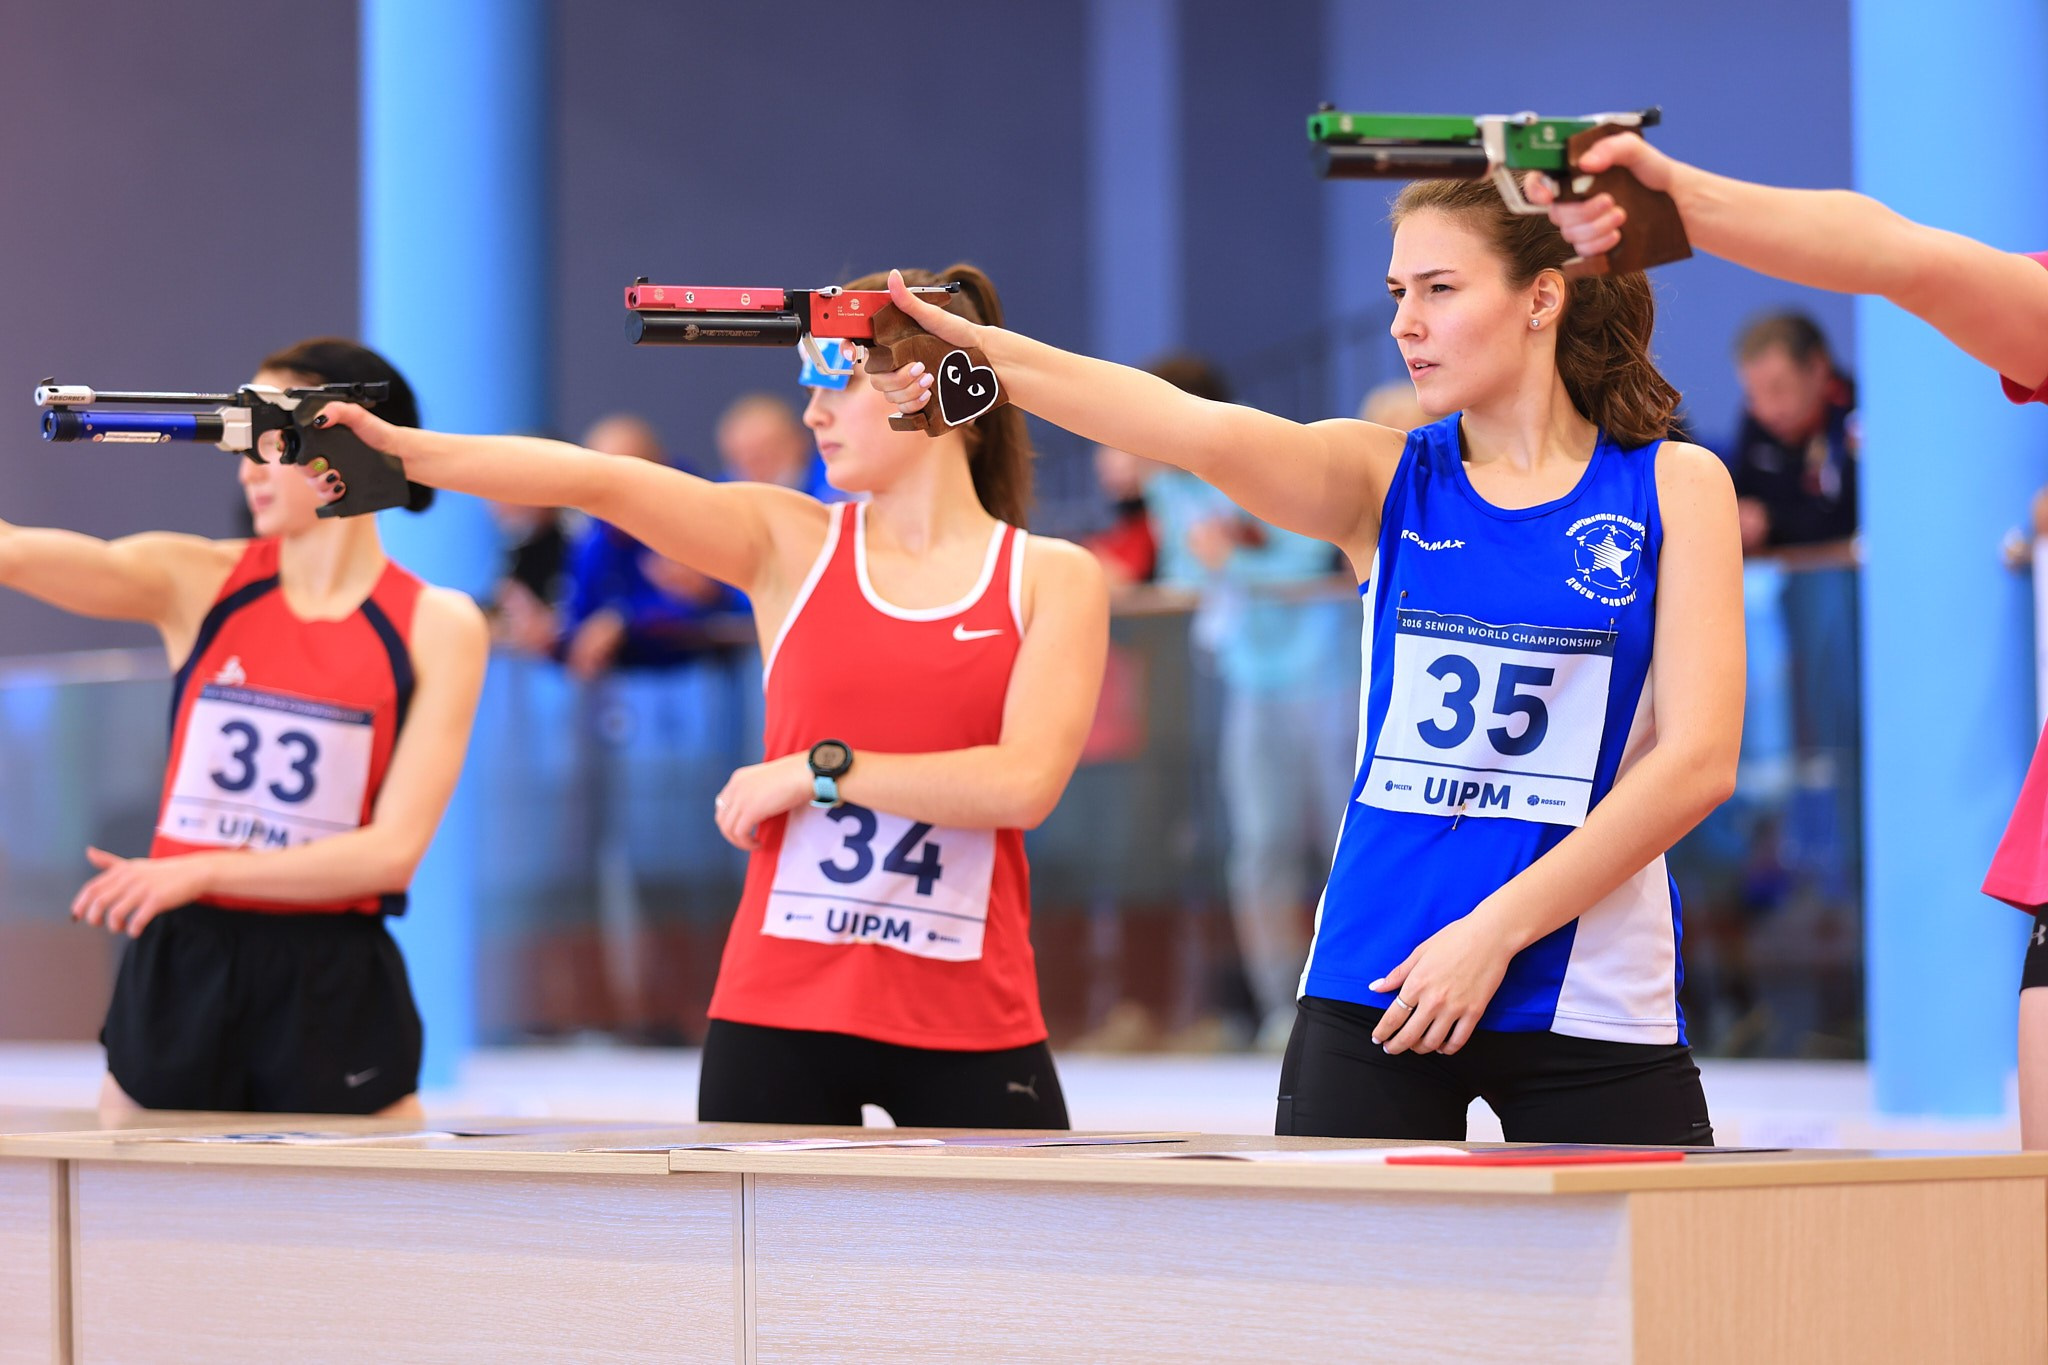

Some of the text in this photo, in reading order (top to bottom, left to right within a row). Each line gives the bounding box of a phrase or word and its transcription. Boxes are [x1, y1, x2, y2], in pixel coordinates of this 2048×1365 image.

[1402, 618, 1602, 648] 2016 SENIOR WORLD CHAMPIONSHIP
[1416, 653, 1556, 757] 35
[210, 719, 321, 804] 33
[1423, 776, 1512, 810] UIPM
[1540, 798, 1567, 807] ROSSETI
[218, 815, 289, 848] UIPM
[818, 800, 943, 896] 34
[826, 909, 912, 943] UIPM
